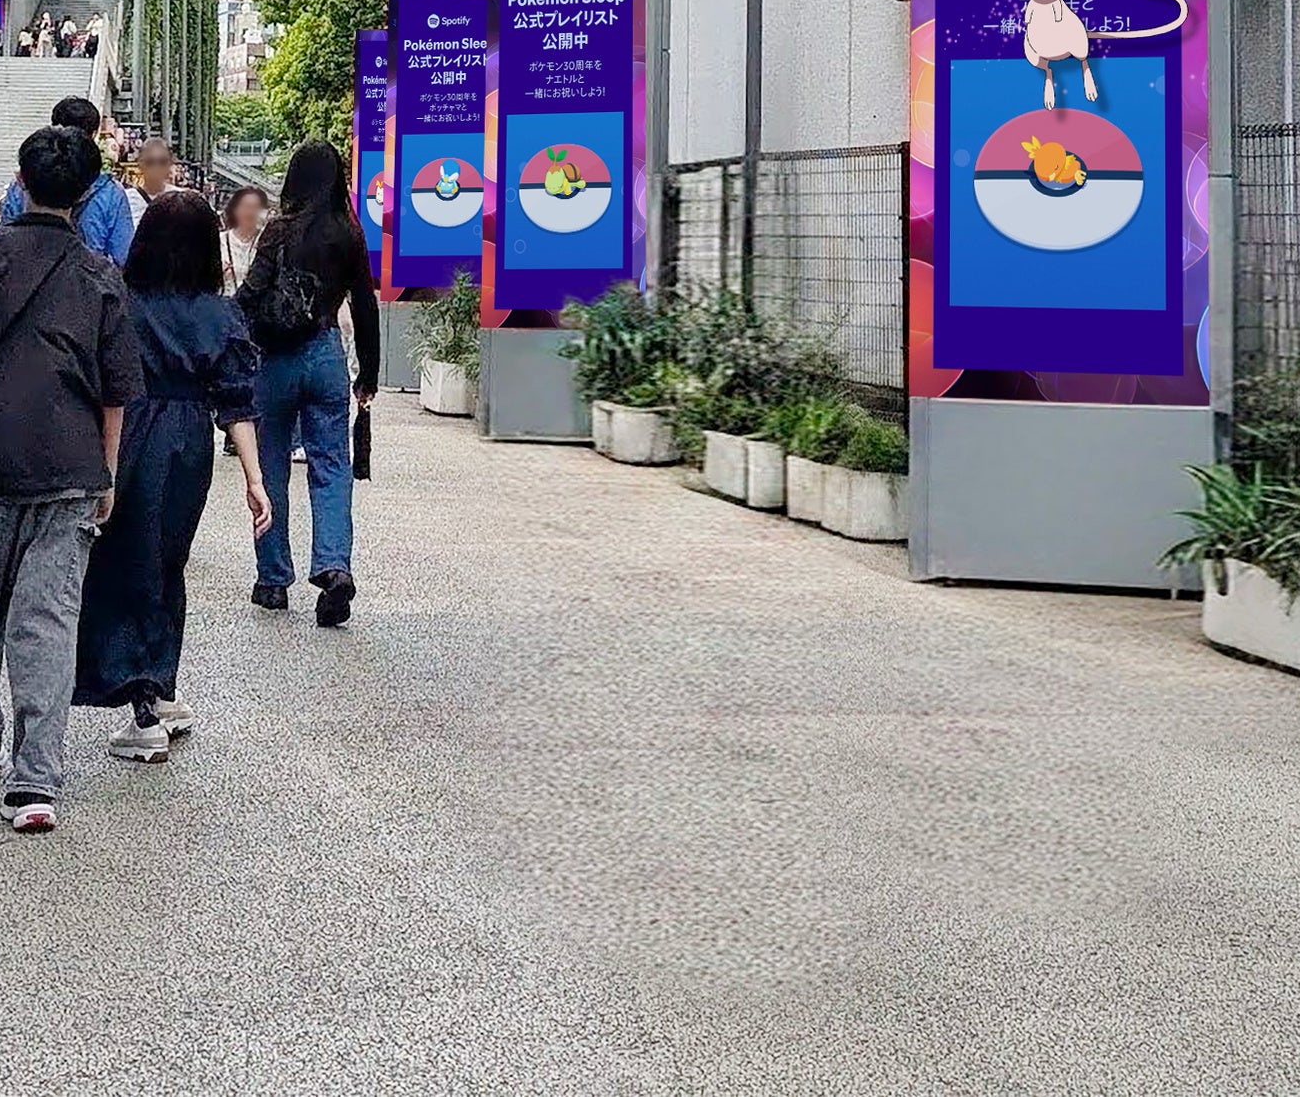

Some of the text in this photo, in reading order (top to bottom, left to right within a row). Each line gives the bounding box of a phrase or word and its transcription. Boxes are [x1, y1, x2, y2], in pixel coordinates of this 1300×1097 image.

[442, 16, 470, 26] Spotify
[514, 9, 618, 29] 公式プレイリスト
[404, 38, 487, 51] Pokémon Slee
[543, 31, 588, 50] 公開中
[529, 60, 601, 71] ポケモン30周年を
[431, 71, 466, 85] 公開中
[546, 74, 584, 84] ナエトルと
